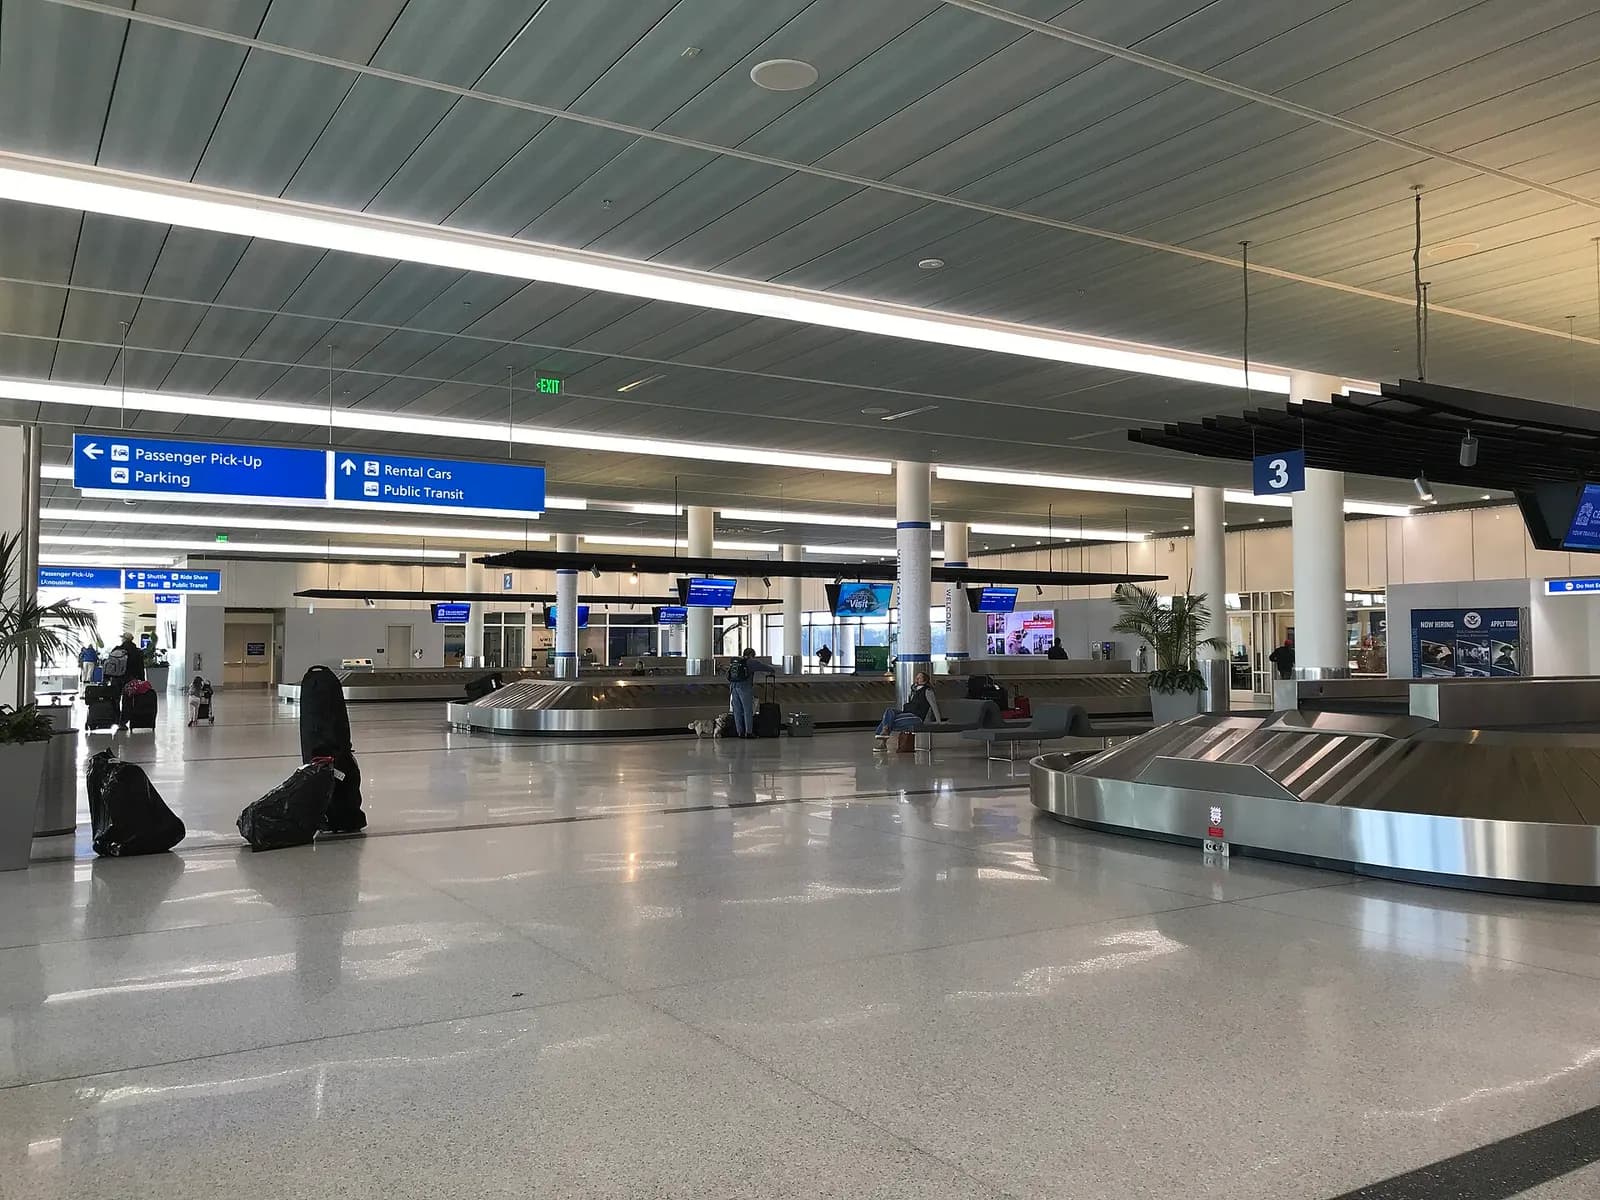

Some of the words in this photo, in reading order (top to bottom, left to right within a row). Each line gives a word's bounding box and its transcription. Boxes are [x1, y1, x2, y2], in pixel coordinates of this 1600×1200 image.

[541, 378, 560, 394] EXIT
[135, 448, 206, 466] Passenger
[211, 453, 263, 469] Pick-Up
[135, 470, 191, 487] Parking
[384, 464, 423, 478] Rental
[427, 468, 452, 480] Cars
[1268, 458, 1289, 489] 3
[384, 485, 421, 498] Public
[424, 487, 464, 500] Transit
[72, 571, 94, 579] Pick-Up
[505, 575, 511, 588] 2
[850, 599, 868, 608] Visit
